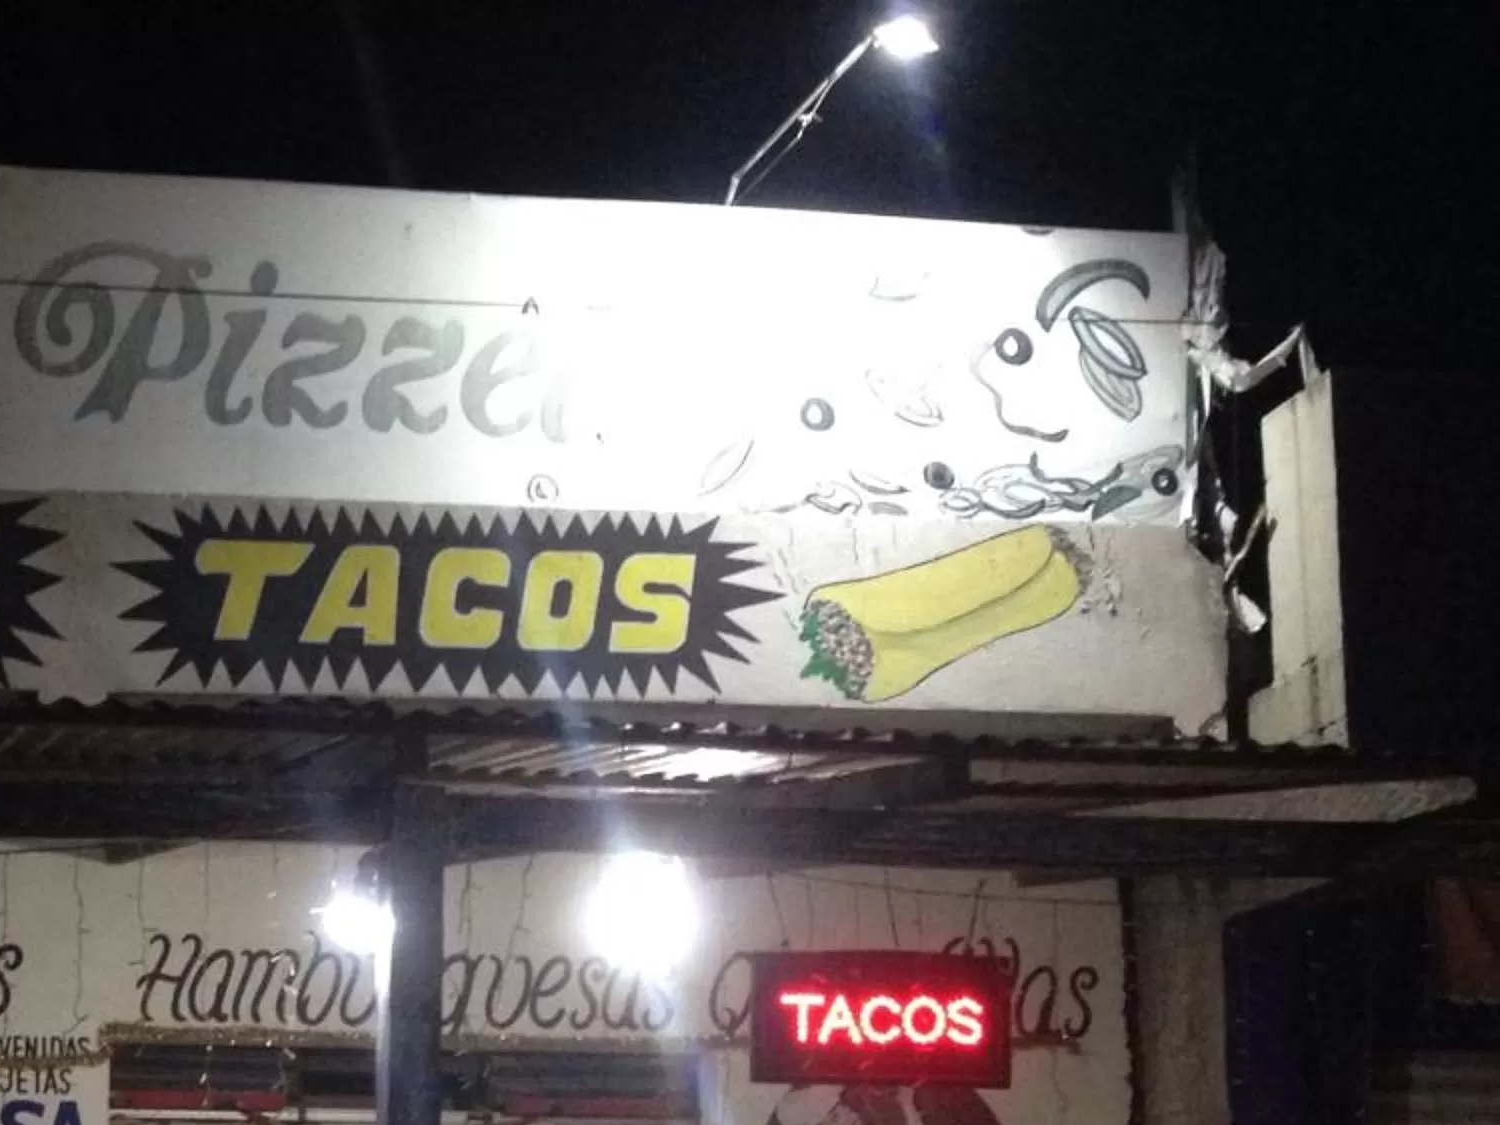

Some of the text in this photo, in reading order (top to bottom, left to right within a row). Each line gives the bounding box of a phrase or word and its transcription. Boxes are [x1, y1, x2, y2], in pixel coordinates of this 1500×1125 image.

[14, 241, 570, 444] Pizze
[195, 539, 697, 653] TACOS
[779, 992, 985, 1046] TACOS
